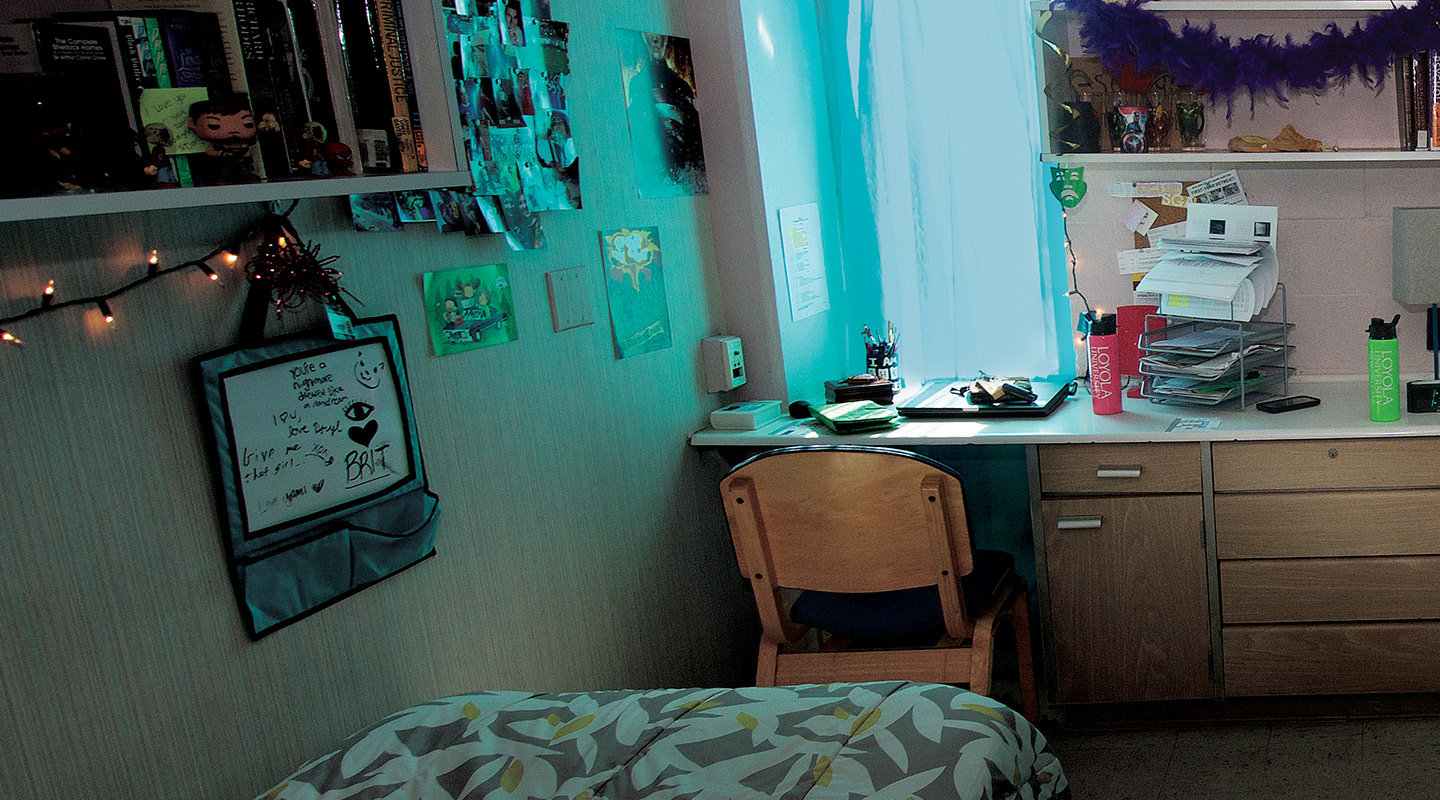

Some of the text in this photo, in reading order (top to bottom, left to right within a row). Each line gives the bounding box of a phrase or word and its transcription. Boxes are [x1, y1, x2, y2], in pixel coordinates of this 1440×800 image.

[245, 0, 263, 60] RICHARD
[384, 0, 407, 103] RIMINAL JUSTICE
[1432, 56, 1440, 103] PSYCHOL
[1091, 346, 1100, 400] UNIVERSITY
[1098, 346, 1112, 399] LOYOLA
[1374, 350, 1382, 406] UNIVERSITY
[1382, 350, 1394, 406] LOYOLA
[243, 447, 275, 467] Give
[285, 444, 301, 456] me
[344, 444, 390, 483] BRIT
